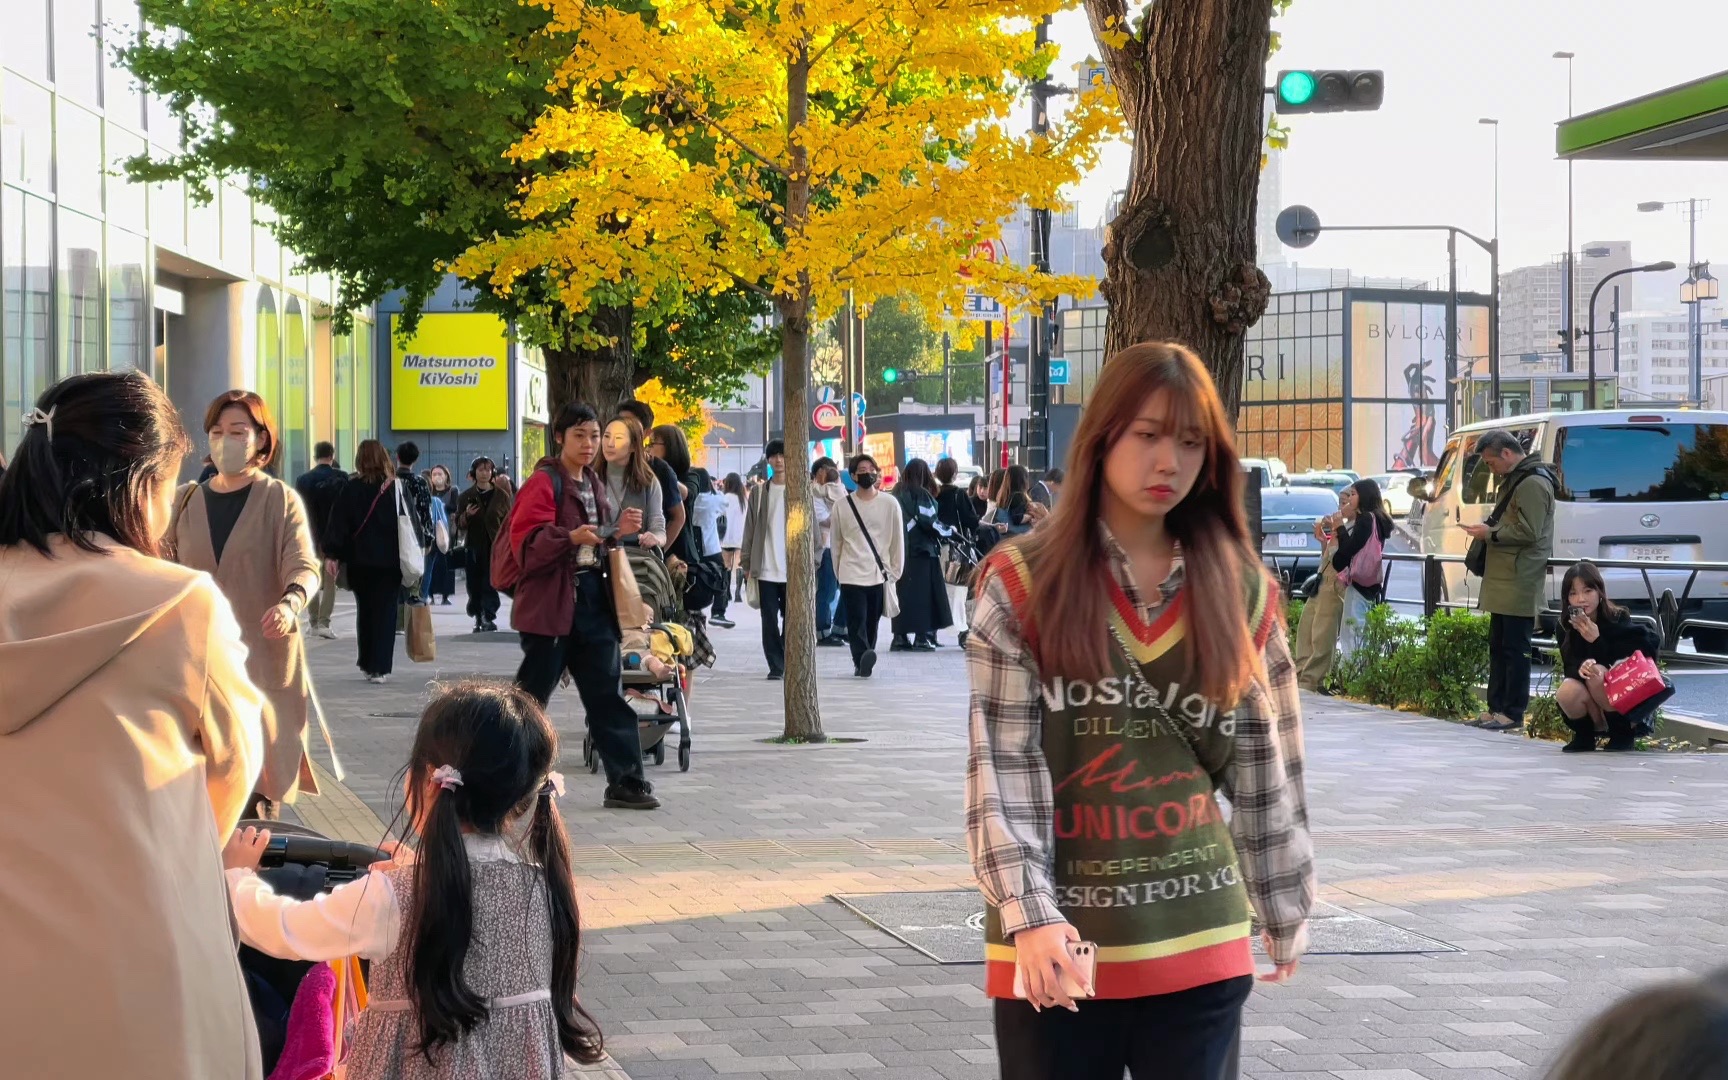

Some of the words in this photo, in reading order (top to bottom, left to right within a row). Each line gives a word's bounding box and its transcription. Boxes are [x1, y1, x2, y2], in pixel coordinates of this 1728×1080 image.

[402, 354, 495, 369] Matsumoto
[419, 372, 479, 386] KiYoshi
[1067, 843, 1218, 876] INDEPENDENT
[1055, 884, 1139, 908] ESIGN
[1142, 873, 1205, 904] FOR
